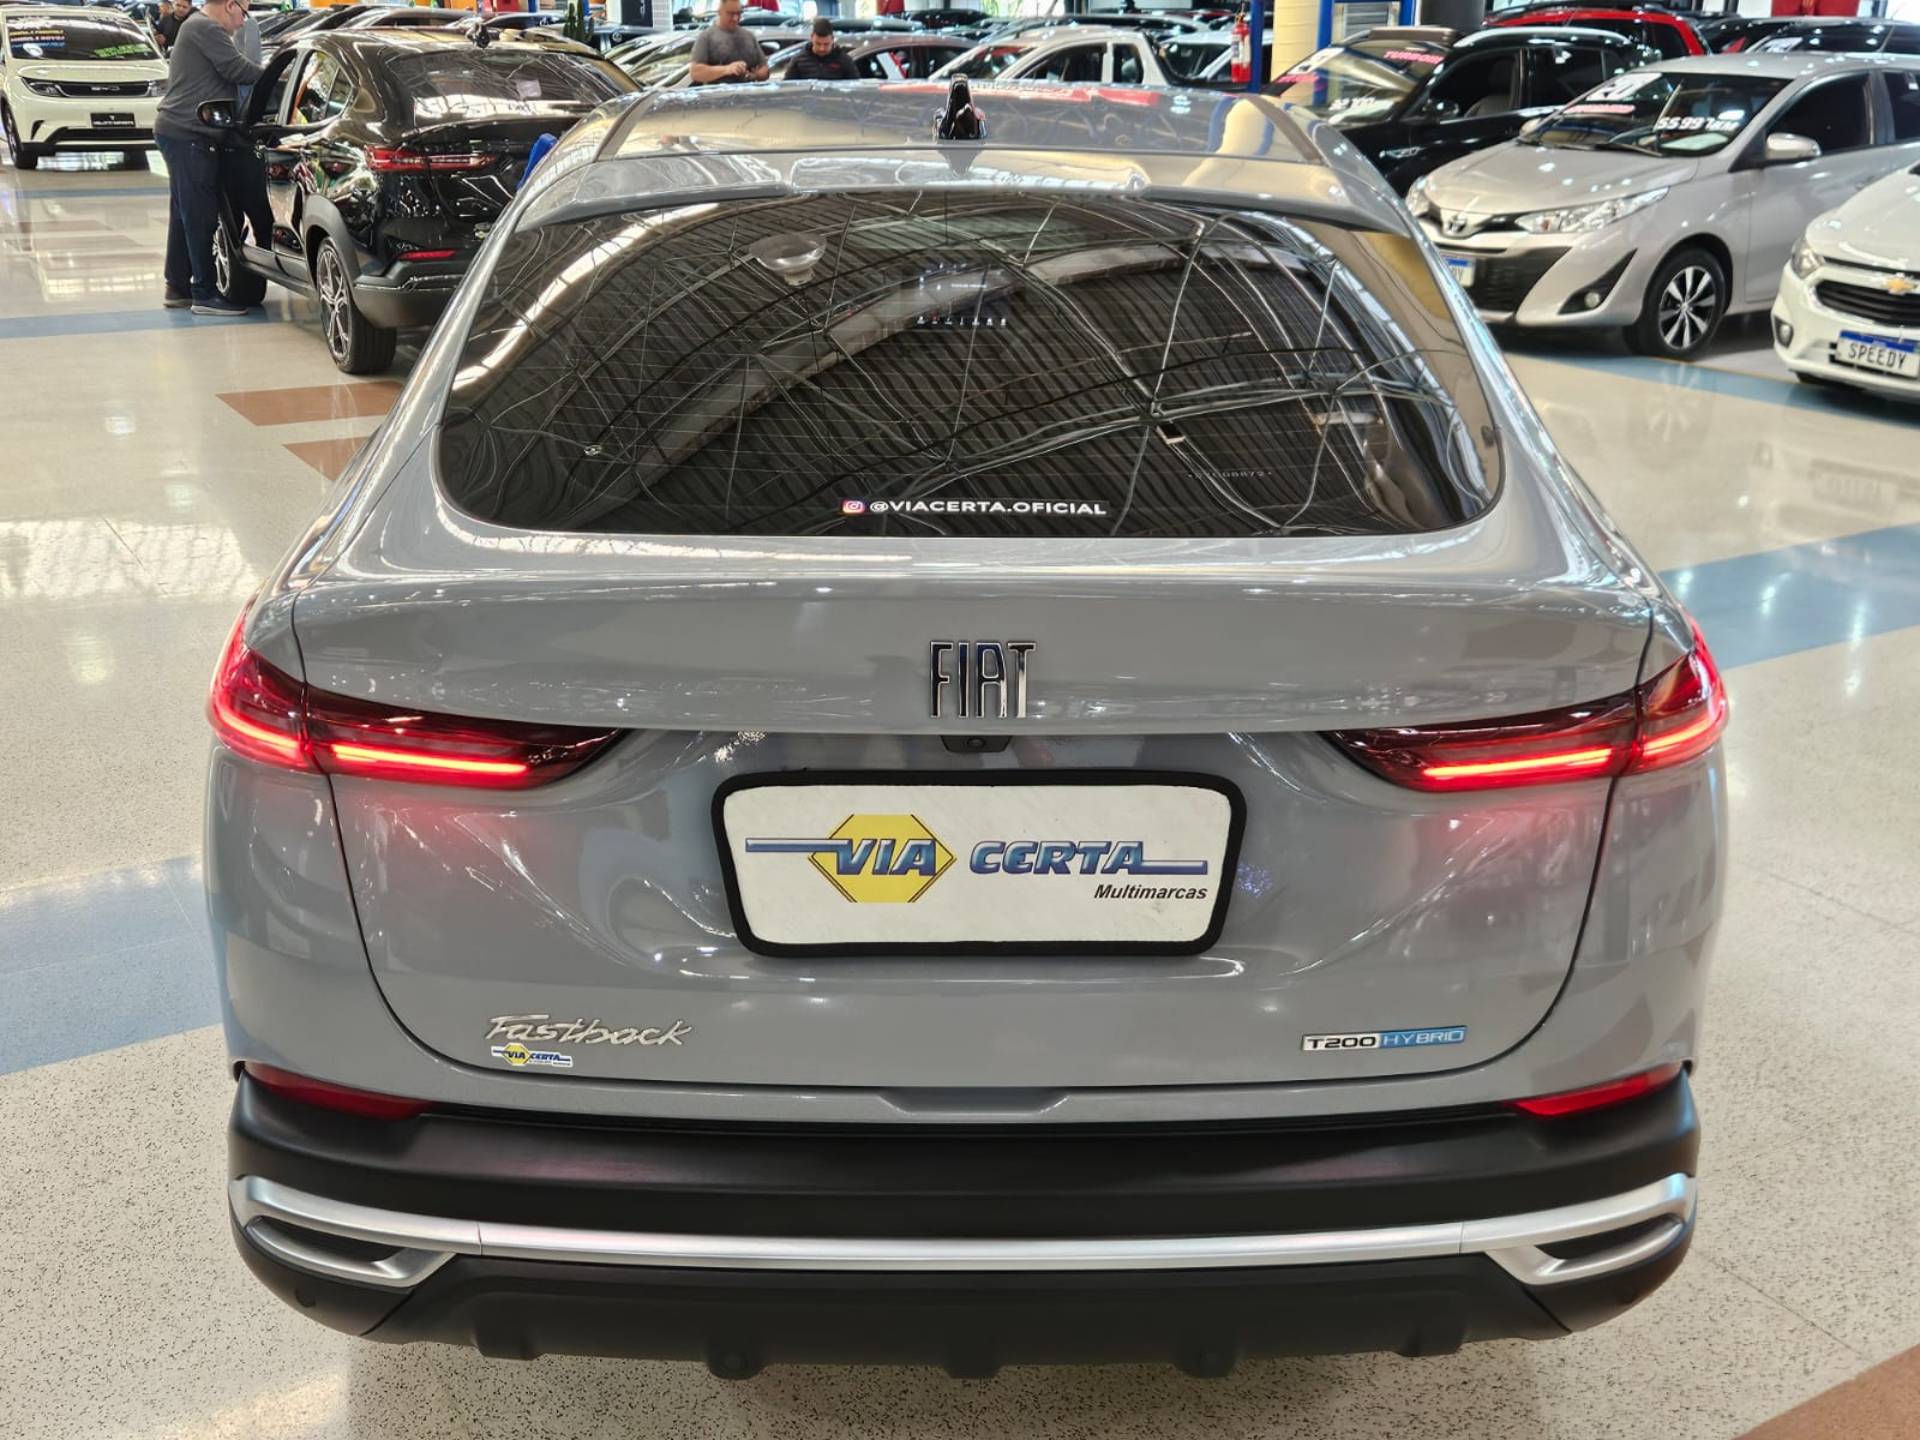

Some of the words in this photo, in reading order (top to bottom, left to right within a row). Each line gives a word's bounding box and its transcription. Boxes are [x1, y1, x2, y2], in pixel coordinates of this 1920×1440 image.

[1848, 342, 1907, 369] SPEEDY
[870, 501, 1107, 516] @VIACERTA.OFICIAL
[929, 640, 1037, 719] FIAT
[834, 838, 936, 876] VIA
[969, 840, 1144, 876] CERTA
[1094, 883, 1208, 901] Multimarcas
[485, 1014, 692, 1046] Fastback
[1307, 1036, 1376, 1049] T200
[1383, 1030, 1465, 1046] HYBRID
[508, 1051, 526, 1060] VIA
[530, 1052, 561, 1062] CERTA
